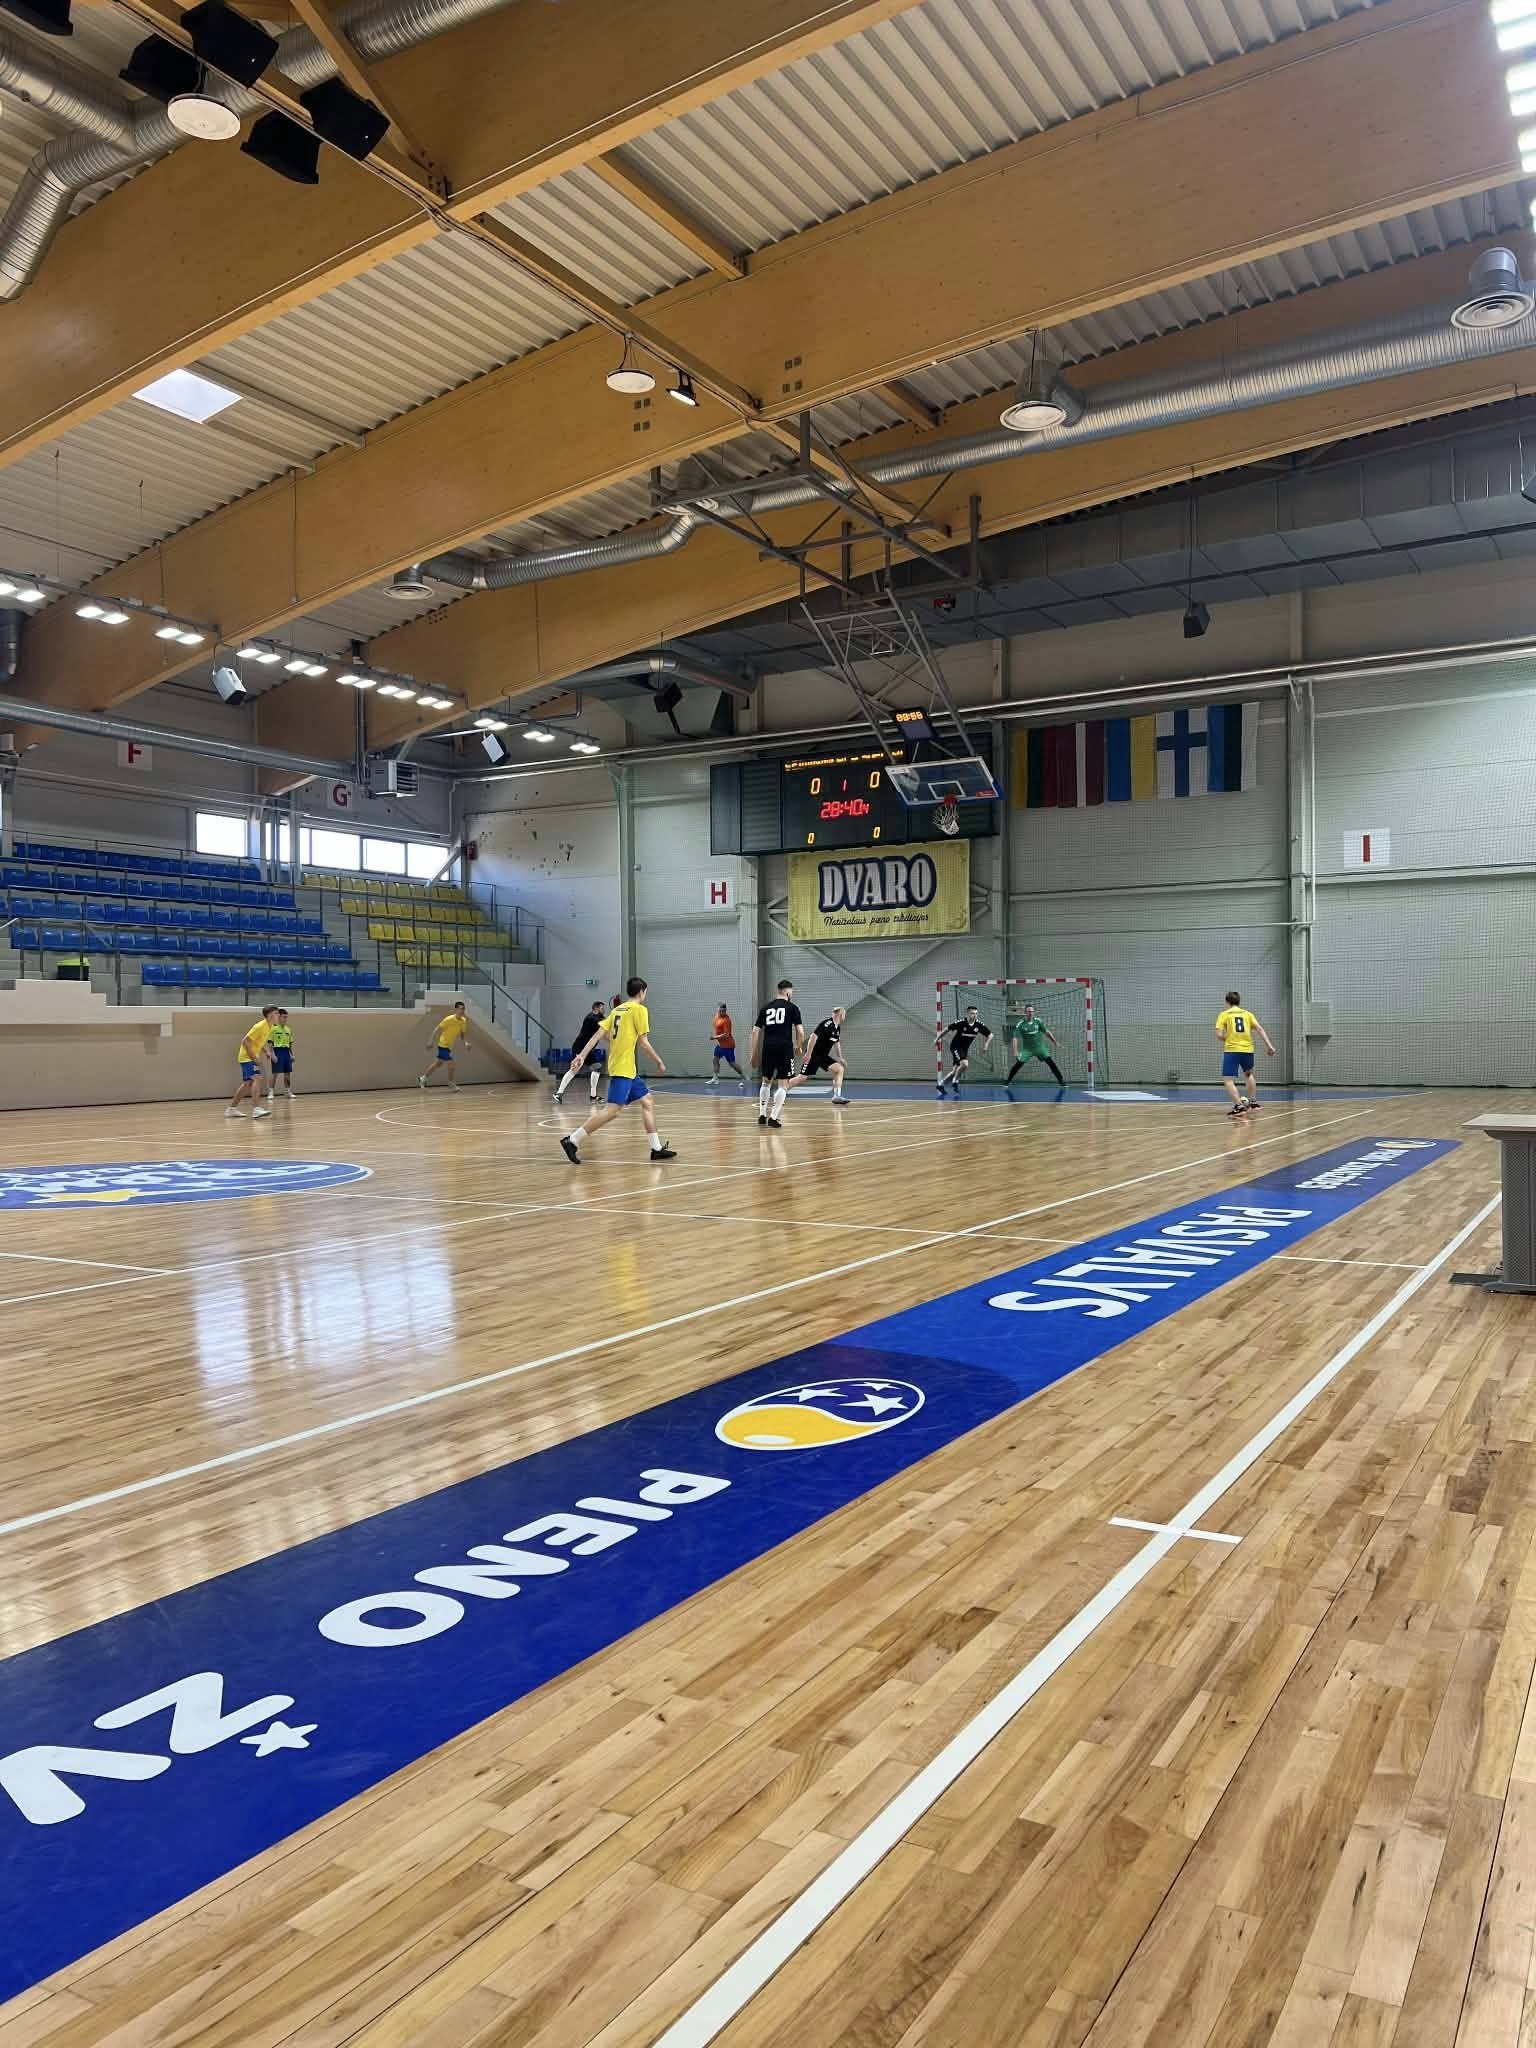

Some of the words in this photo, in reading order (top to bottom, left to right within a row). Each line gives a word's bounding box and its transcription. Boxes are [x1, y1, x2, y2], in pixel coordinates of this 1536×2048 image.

[332, 783, 348, 806] G
[810, 777, 821, 795] 0
[869, 771, 880, 789] 0
[807, 832, 815, 844] 0
[873, 826, 881, 839] 0
[710, 881, 727, 905] H
[819, 854, 936, 911] DVARO
[612, 1014, 622, 1040] 5
[766, 1007, 785, 1025] 20
[1234, 1016, 1245, 1033] 8
[988, 1205, 1313, 1319] PASVALYS
[318, 1468, 732, 1648] PIENO
